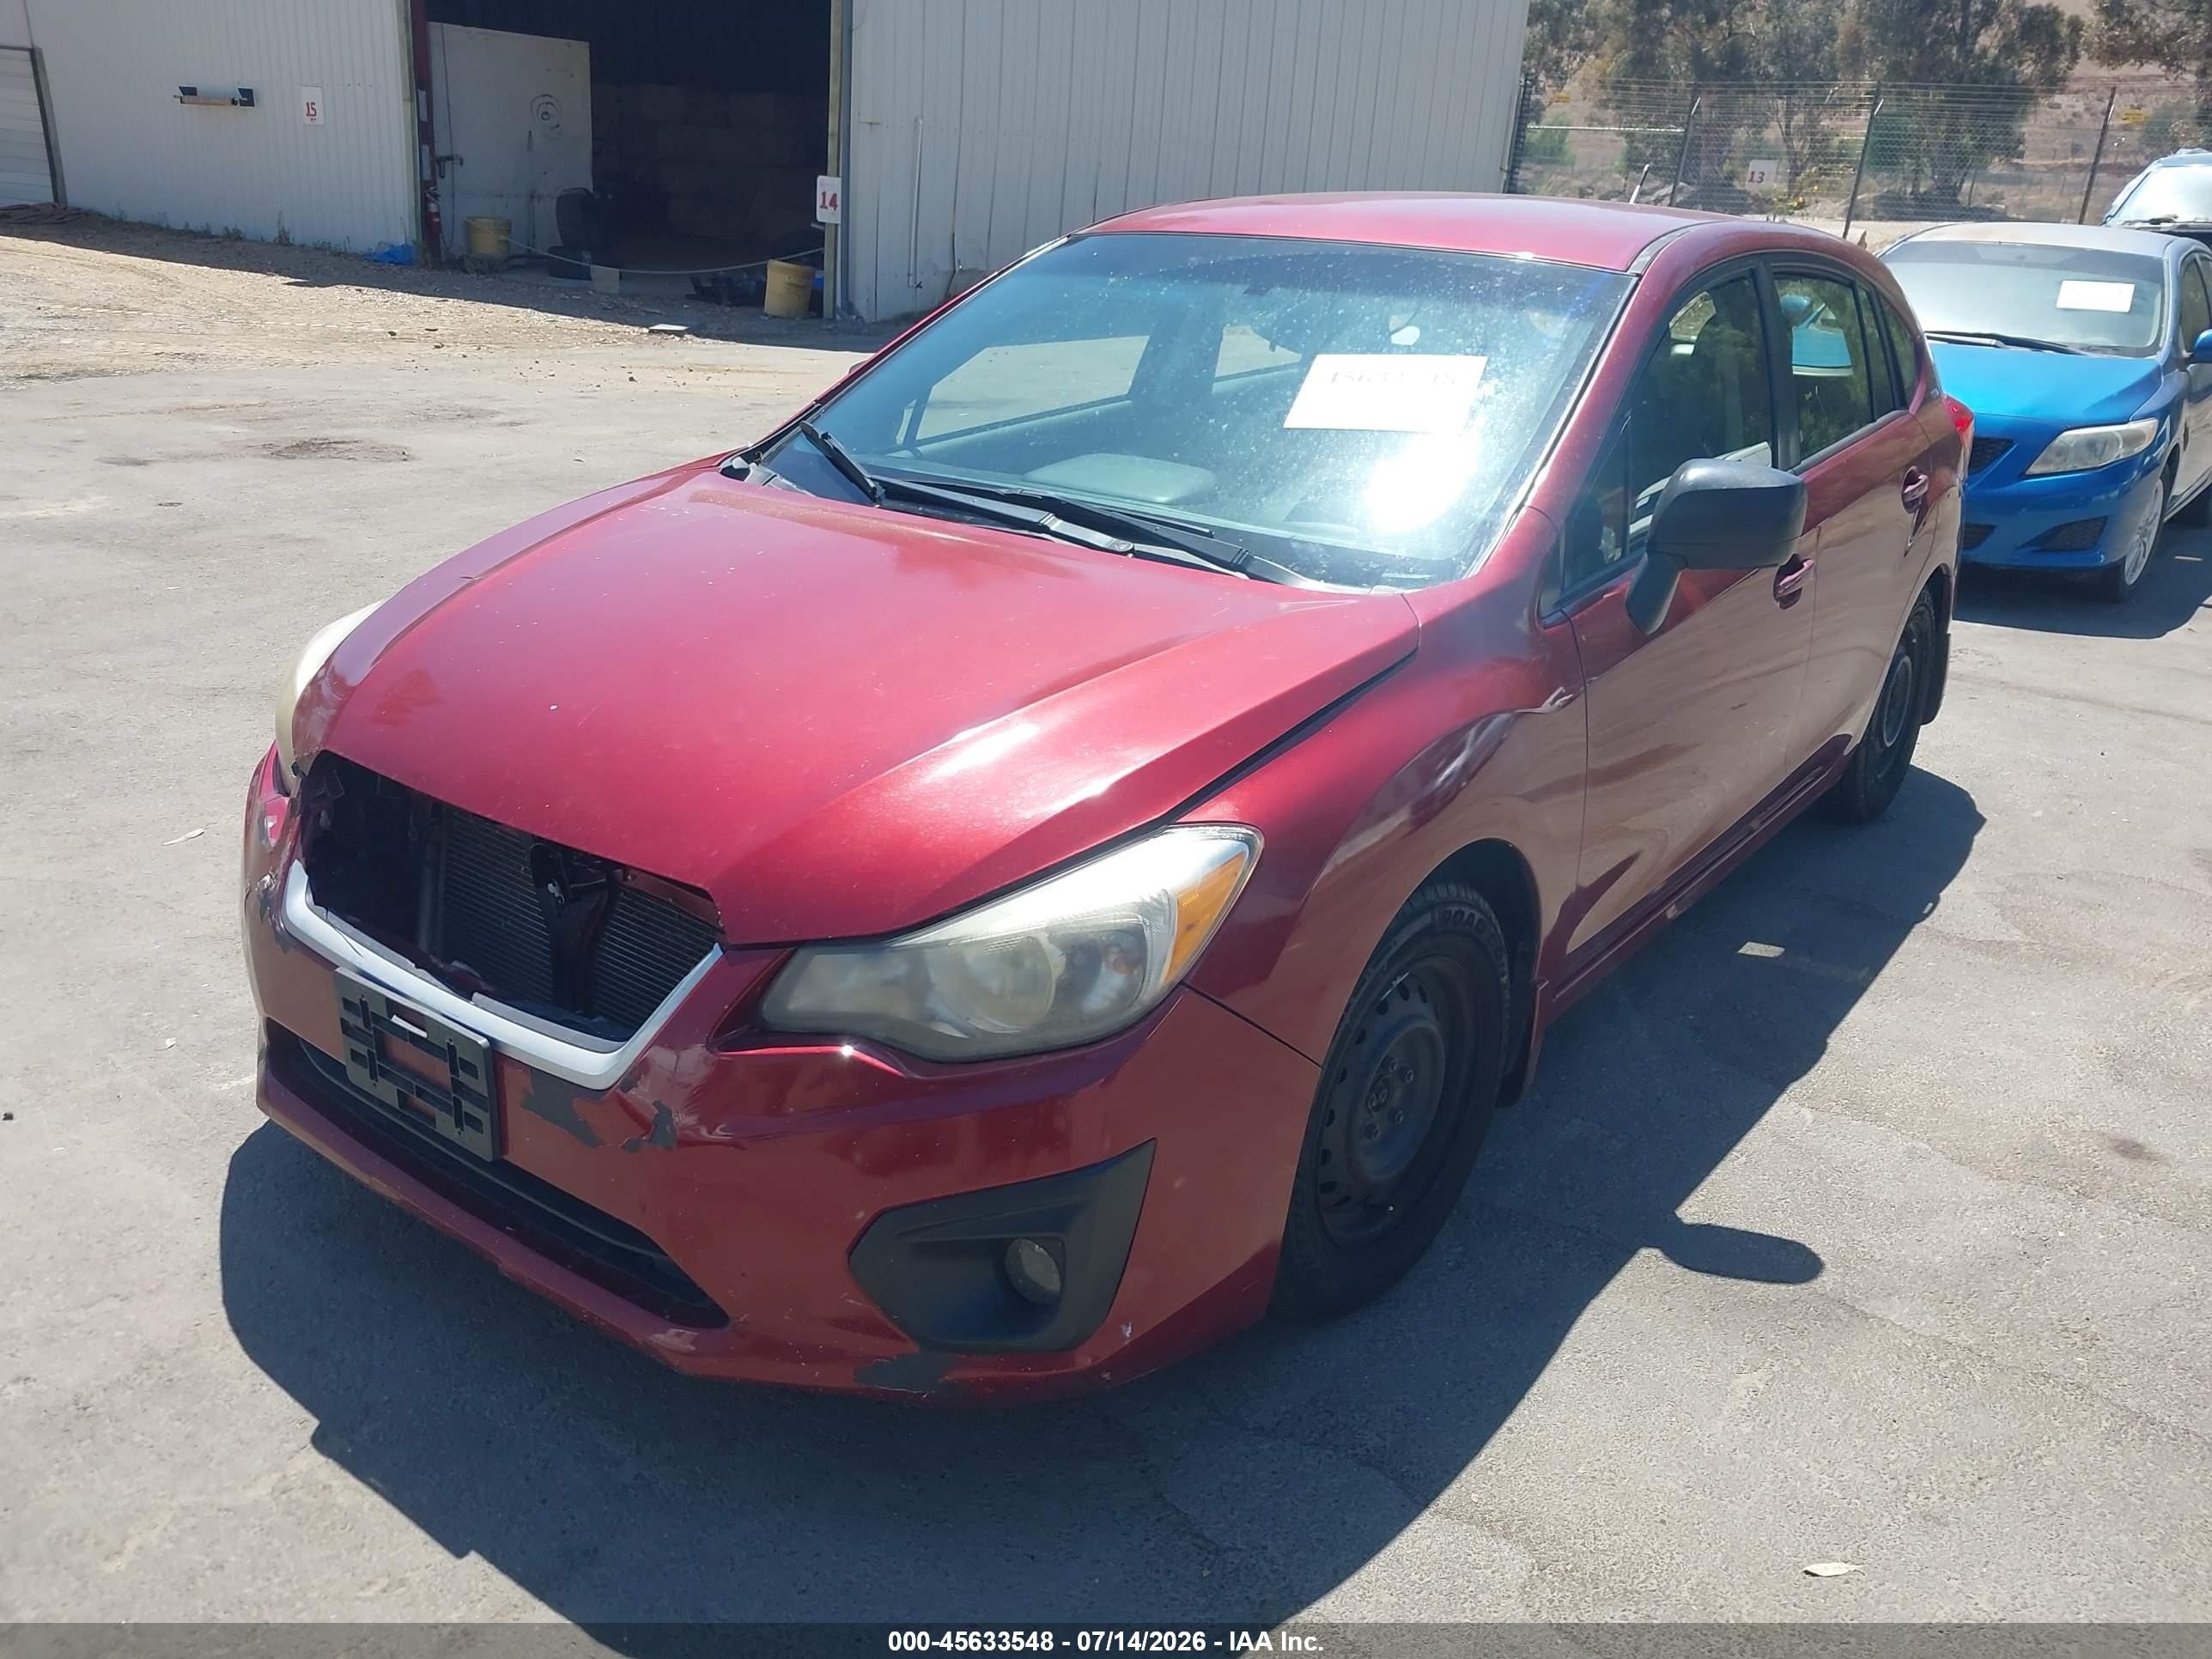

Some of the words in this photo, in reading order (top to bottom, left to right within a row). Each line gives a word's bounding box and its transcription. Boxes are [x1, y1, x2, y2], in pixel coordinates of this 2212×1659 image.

[306, 101, 317, 117] 15
[1747, 171, 1765, 183] 13
[819, 191, 838, 211] 14
